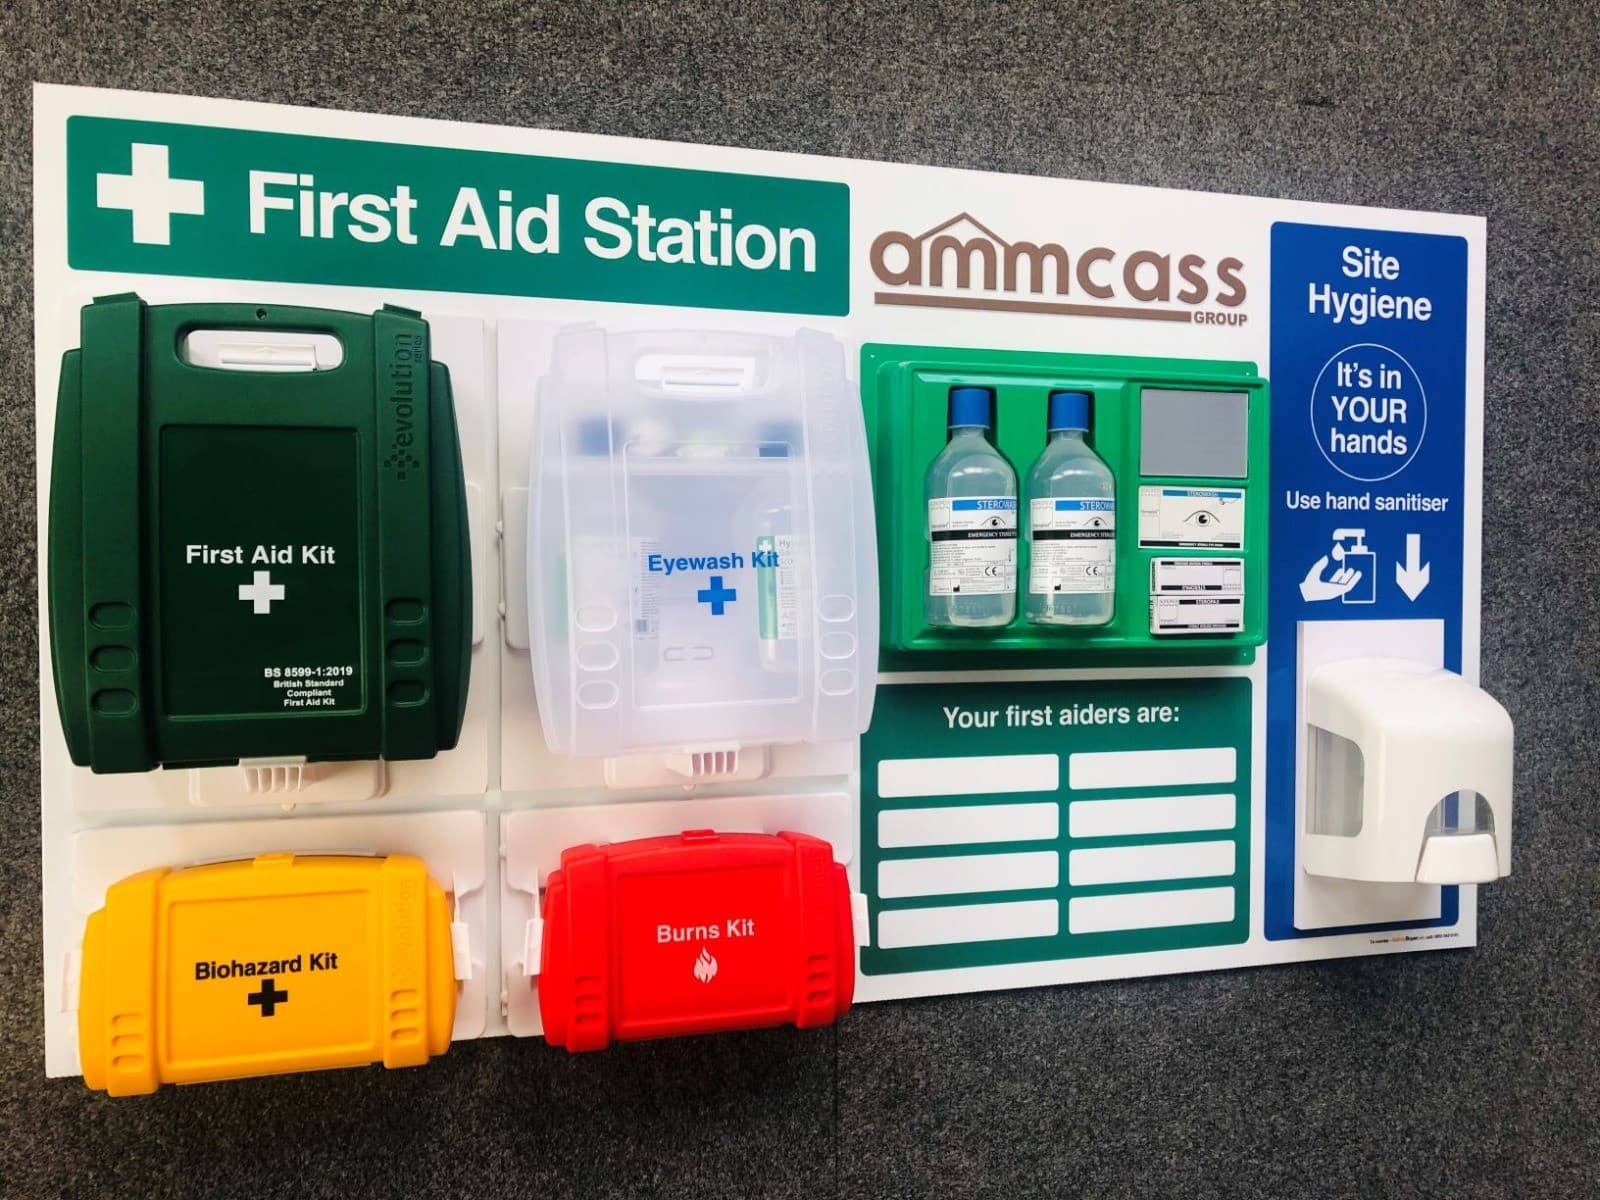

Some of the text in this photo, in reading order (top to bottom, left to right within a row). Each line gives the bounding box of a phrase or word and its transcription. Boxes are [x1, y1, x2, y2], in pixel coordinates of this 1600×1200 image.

[249, 170, 817, 272] First Aid Station
[869, 229, 1247, 308] ammcass
[1342, 245, 1400, 280] Site
[1308, 282, 1432, 325] Hygiene
[1193, 311, 1248, 327] GROUP
[1337, 361, 1402, 389] It's in
[390, 333, 414, 448] evolution
[1331, 396, 1407, 423] YOUR
[1330, 428, 1408, 456] hands
[1286, 491, 1449, 512] Use hand sanitiser
[186, 544, 335, 565] First Aid Kit
[648, 551, 779, 575] Eyewash Kit
[264, 666, 353, 678] BS 8599-1:2019
[273, 680, 303, 688] British
[286, 689, 332, 698] Compliant
[306, 698, 321, 706] Aid
[943, 704, 1180, 729] Your first aiders are:
[657, 918, 755, 943] Burns Kit
[195, 952, 338, 980] Biohazard Kit
